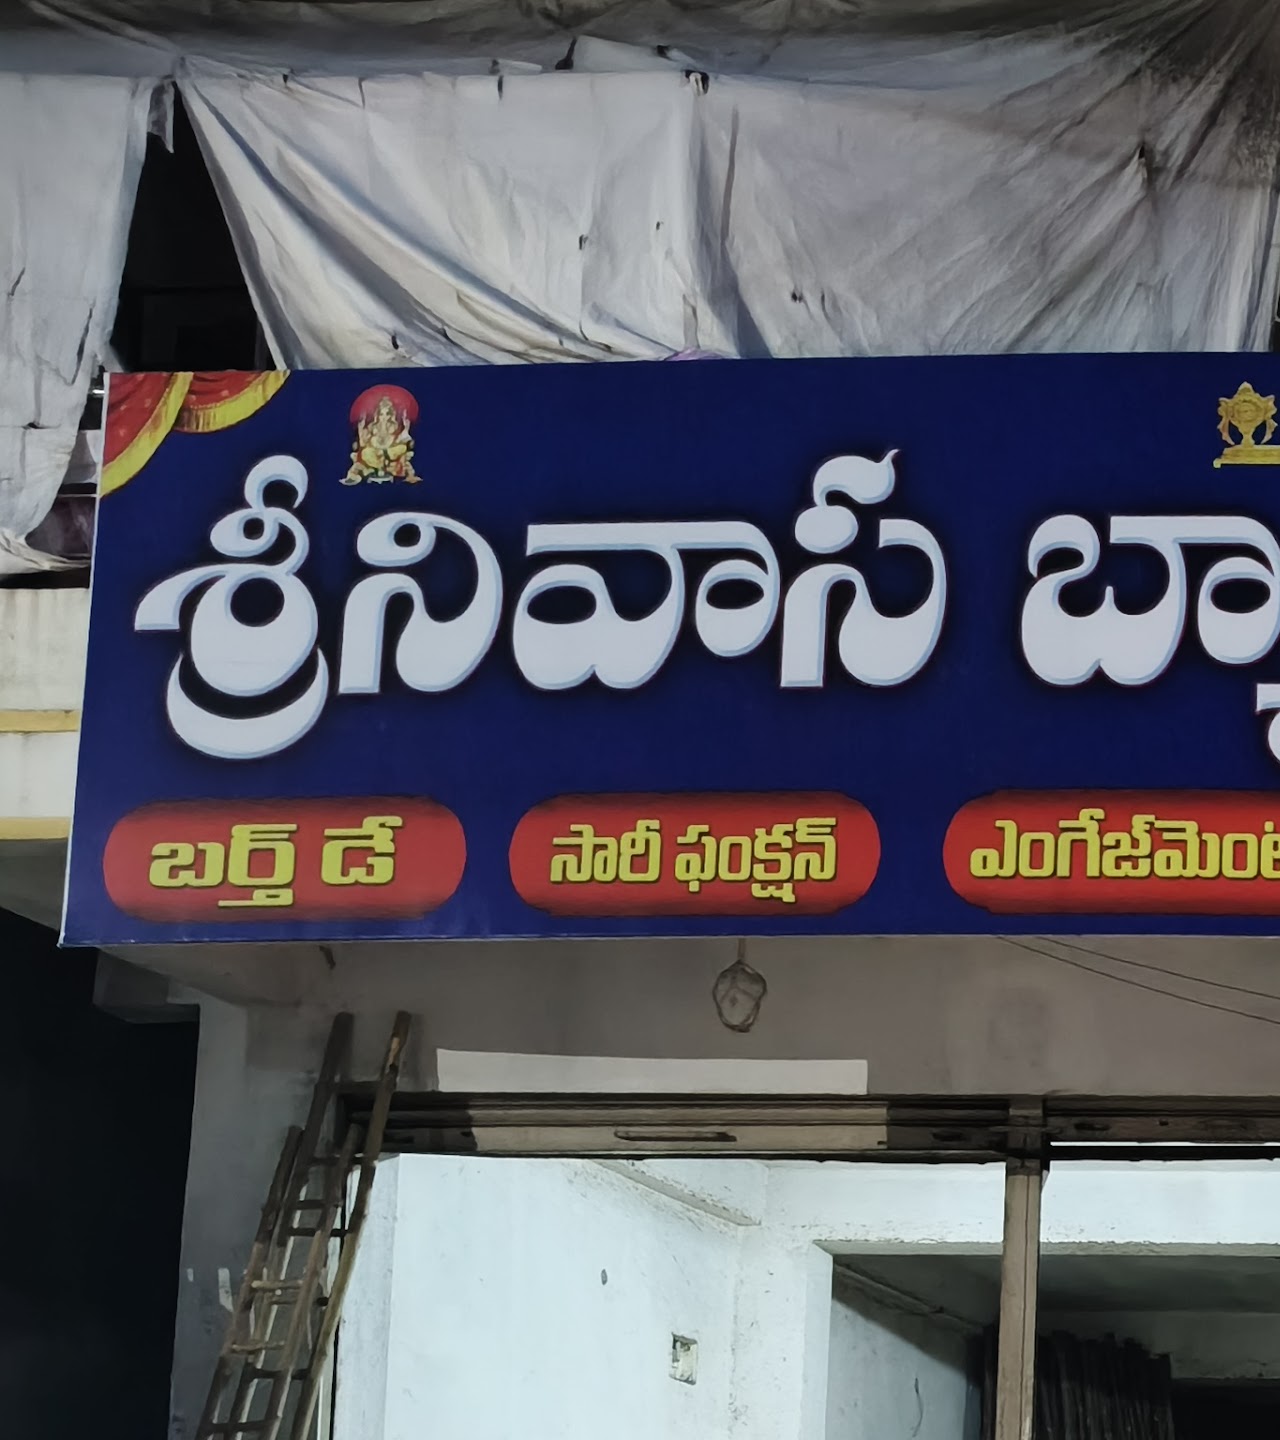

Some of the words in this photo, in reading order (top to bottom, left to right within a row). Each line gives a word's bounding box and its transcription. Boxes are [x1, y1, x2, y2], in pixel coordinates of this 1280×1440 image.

[134, 449, 946, 759] శ్రీనివాస
[320, 815, 403, 885] డే
[549, 819, 661, 882] సారీ
[674, 817, 837, 903] ఫంక్షన్
